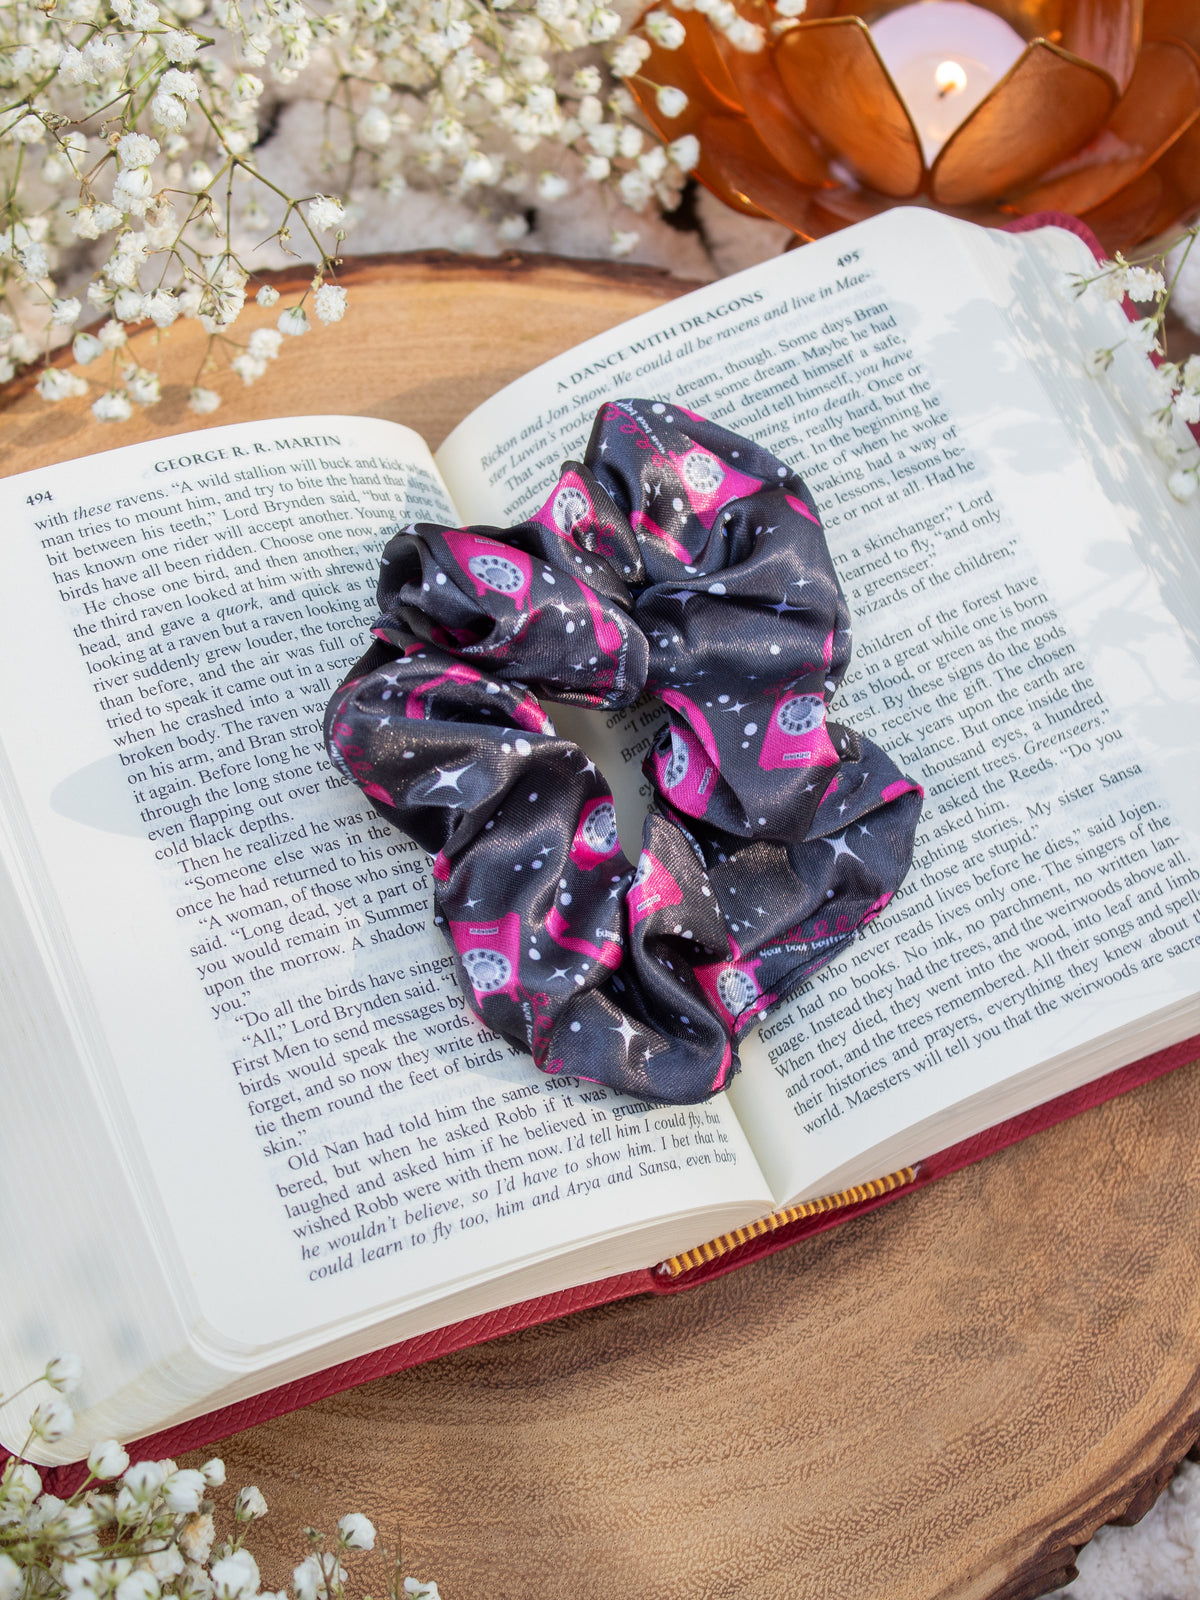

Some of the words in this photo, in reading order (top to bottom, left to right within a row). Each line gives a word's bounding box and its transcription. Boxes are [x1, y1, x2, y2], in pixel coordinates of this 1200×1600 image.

[837, 251, 859, 267] 495
[557, 381, 571, 395] A
[570, 350, 626, 384] DANCE
[630, 327, 677, 354] WITH
[680, 293, 763, 332] DRAGONS
[676, 373, 723, 396] dream,
[725, 348, 772, 374] though.
[778, 331, 816, 352] Some
[822, 319, 852, 335] days
[854, 303, 888, 321] Bran
[682, 394, 711, 418] just
[715, 378, 749, 398] some
[754, 359, 796, 381] dream.
[802, 338, 847, 361] Maybe
[850, 330, 867, 341] he
[870, 315, 897, 333] had
[34, 512, 69, 530] with
[73, 503, 111, 521] these
[116, 489, 169, 509] ravens.
[197, 472, 231, 488] wild
[234, 465, 287, 482] stallion
[290, 459, 317, 472] will
[319, 457, 352, 469] buck
[355, 459, 378, 468] and
[379, 458, 403, 471] kick
[154, 449, 226, 472] GEORGE
[232, 446, 249, 457] R.
[253, 443, 271, 453] R.
[275, 436, 341, 450] MARTIN
[26, 490, 53, 507] 494
[41, 532, 75, 549] man
[78, 522, 112, 538] tries
[115, 517, 131, 528] to
[135, 503, 183, 523] mount
[185, 496, 221, 510] him,
[224, 486, 251, 502] and
[254, 485, 274, 498] try
[279, 483, 293, 492] to
[296, 477, 323, 489] bite
[326, 474, 347, 486] the
[349, 473, 381, 485] hand
[383, 475, 403, 486] that
[838, 552, 892, 583] learned
[893, 549, 909, 560] to
[911, 539, 934, 553] fly,
[972, 510, 1000, 528] only
[854, 588, 909, 617] wizards
[911, 577, 926, 593] of
[928, 572, 951, 586] the
[827, 696, 849, 714] red
[852, 689, 868, 703] as
[868, 667, 915, 694] blood,
[917, 661, 931, 674] or
[936, 644, 975, 669] green
[978, 636, 993, 649] as
[995, 626, 1018, 641] the
[1021, 610, 1057, 631] moss
[921, 740, 986, 778] thousand
[991, 729, 1028, 749] eyes,
[1032, 721, 1042, 731] a
[1044, 691, 1104, 725] hundred
[148, 822, 185, 841] even
[188, 802, 254, 829] flapping
[258, 791, 284, 808] out
[288, 782, 321, 800] over
[324, 774, 349, 789] the
[929, 766, 981, 797] ancient
[982, 752, 1021, 773] trees.
[971, 817, 1023, 843] stories.
[1026, 802, 1051, 819] My
[1058, 783, 1094, 806] sister
[1099, 764, 1142, 788] Sansa
[155, 838, 189, 860] cold
[191, 825, 236, 849] black
[239, 812, 294, 835] depths.
[176, 898, 213, 918] once
[215, 891, 236, 905] he
[238, 877, 269, 898] had
[272, 857, 338, 888] returned
[340, 856, 356, 868] to
[357, 846, 384, 863] his
[386, 840, 418, 855] own
[196, 959, 227, 980] you
[231, 938, 281, 964] would
[285, 924, 341, 949] remain
[345, 918, 361, 930] in
[364, 899, 433, 925] Summer
[768, 1032, 810, 1064] guage.
[809, 997, 862, 1035] Instead
[862, 984, 893, 1006] they
[894, 966, 925, 990] had
[925, 958, 949, 975] the
[950, 941, 992, 964] trees,
[992, 922, 1019, 945] and
[1020, 916, 1044, 932] the
[1045, 880, 1123, 920] weirwoods
[1124, 863, 1166, 887] above
[1166, 850, 1188, 868] all.
[238, 1072, 281, 1096] birds
[287, 1052, 337, 1079] would
[342, 1038, 388, 1064] speak
[393, 1031, 418, 1046] the
[423, 1016, 475, 1036] words.
[793, 1092, 823, 1116] their
[826, 1057, 887, 1096] histories
[892, 1037, 920, 1061] and
[924, 1013, 983, 1049] prayers,
[987, 974, 1065, 1015] everything
[1067, 958, 1098, 978] they
[1102, 939, 1142, 963] knew
[1148, 918, 1189, 943] about
[803, 1102, 844, 1134] world.
[845, 1068, 911, 1109] Maesters
[913, 1049, 943, 1072] will
[945, 1036, 970, 1058] tell
[972, 1025, 1001, 1048] you
[1003, 1009, 1032, 1030] that
[1034, 999, 1058, 1016] the
[1060, 964, 1137, 1003] weirwoods
[1141, 953, 1164, 970] are
[301, 1245, 318, 1259] he
[404, 1198, 463, 1224] believe,
[472, 1189, 488, 1202] so
[522, 1168, 557, 1186] have
[565, 1162, 578, 1173] to
[586, 1150, 620, 1168] show
[626, 1142, 655, 1157] him.
[671, 1134, 689, 1147] bet
[694, 1130, 715, 1143] that
[718, 1131, 728, 1143] he
[309, 1252, 353, 1281] could
[361, 1240, 403, 1263] learn
[411, 1233, 426, 1246] to
[433, 1222, 452, 1241] fly
[460, 1214, 489, 1230] too,
[496, 1200, 524, 1218] him
[532, 1185, 560, 1207] and
[566, 1178, 601, 1197] Arya
[607, 1165, 633, 1185] and
[638, 1160, 681, 1177] Sansa,
[686, 1154, 711, 1167] even
[713, 1148, 736, 1163] baby
